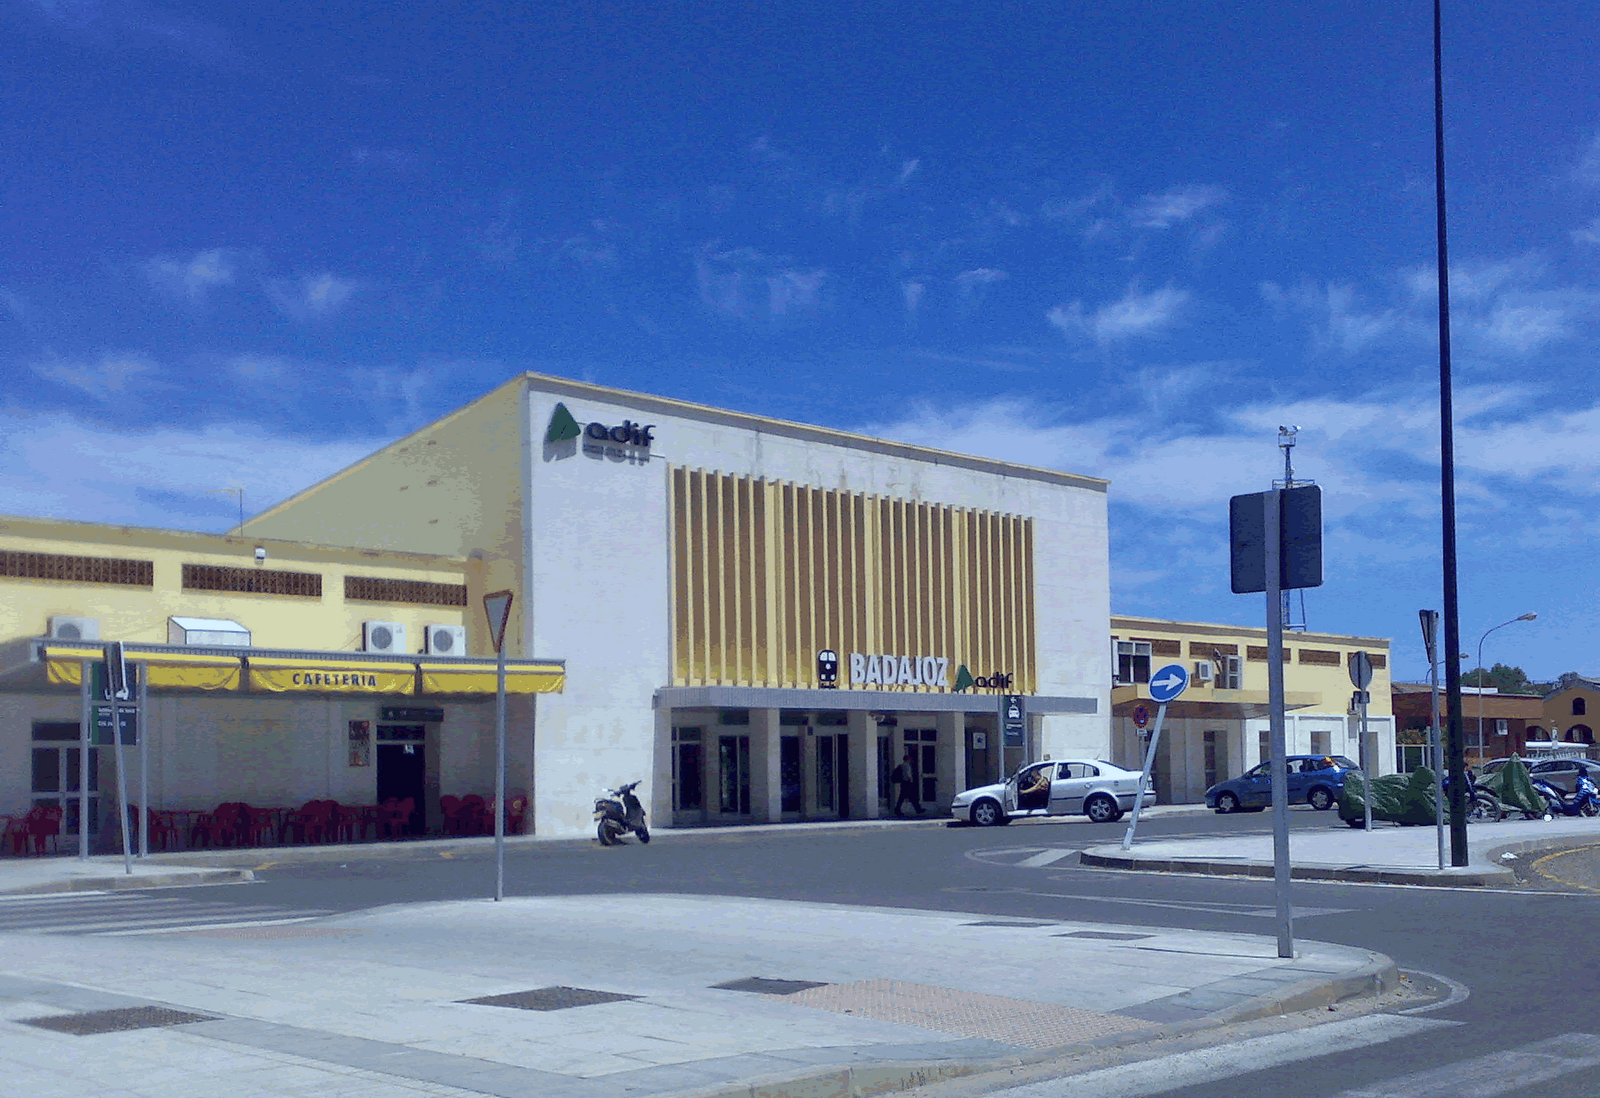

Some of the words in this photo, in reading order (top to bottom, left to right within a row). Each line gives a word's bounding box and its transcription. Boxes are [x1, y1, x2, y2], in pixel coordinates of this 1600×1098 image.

[585, 420, 656, 446] adif
[292, 673, 376, 686] CAFETERIA
[850, 653, 948, 686] BADAJOZ
[974, 672, 1013, 688] adif
